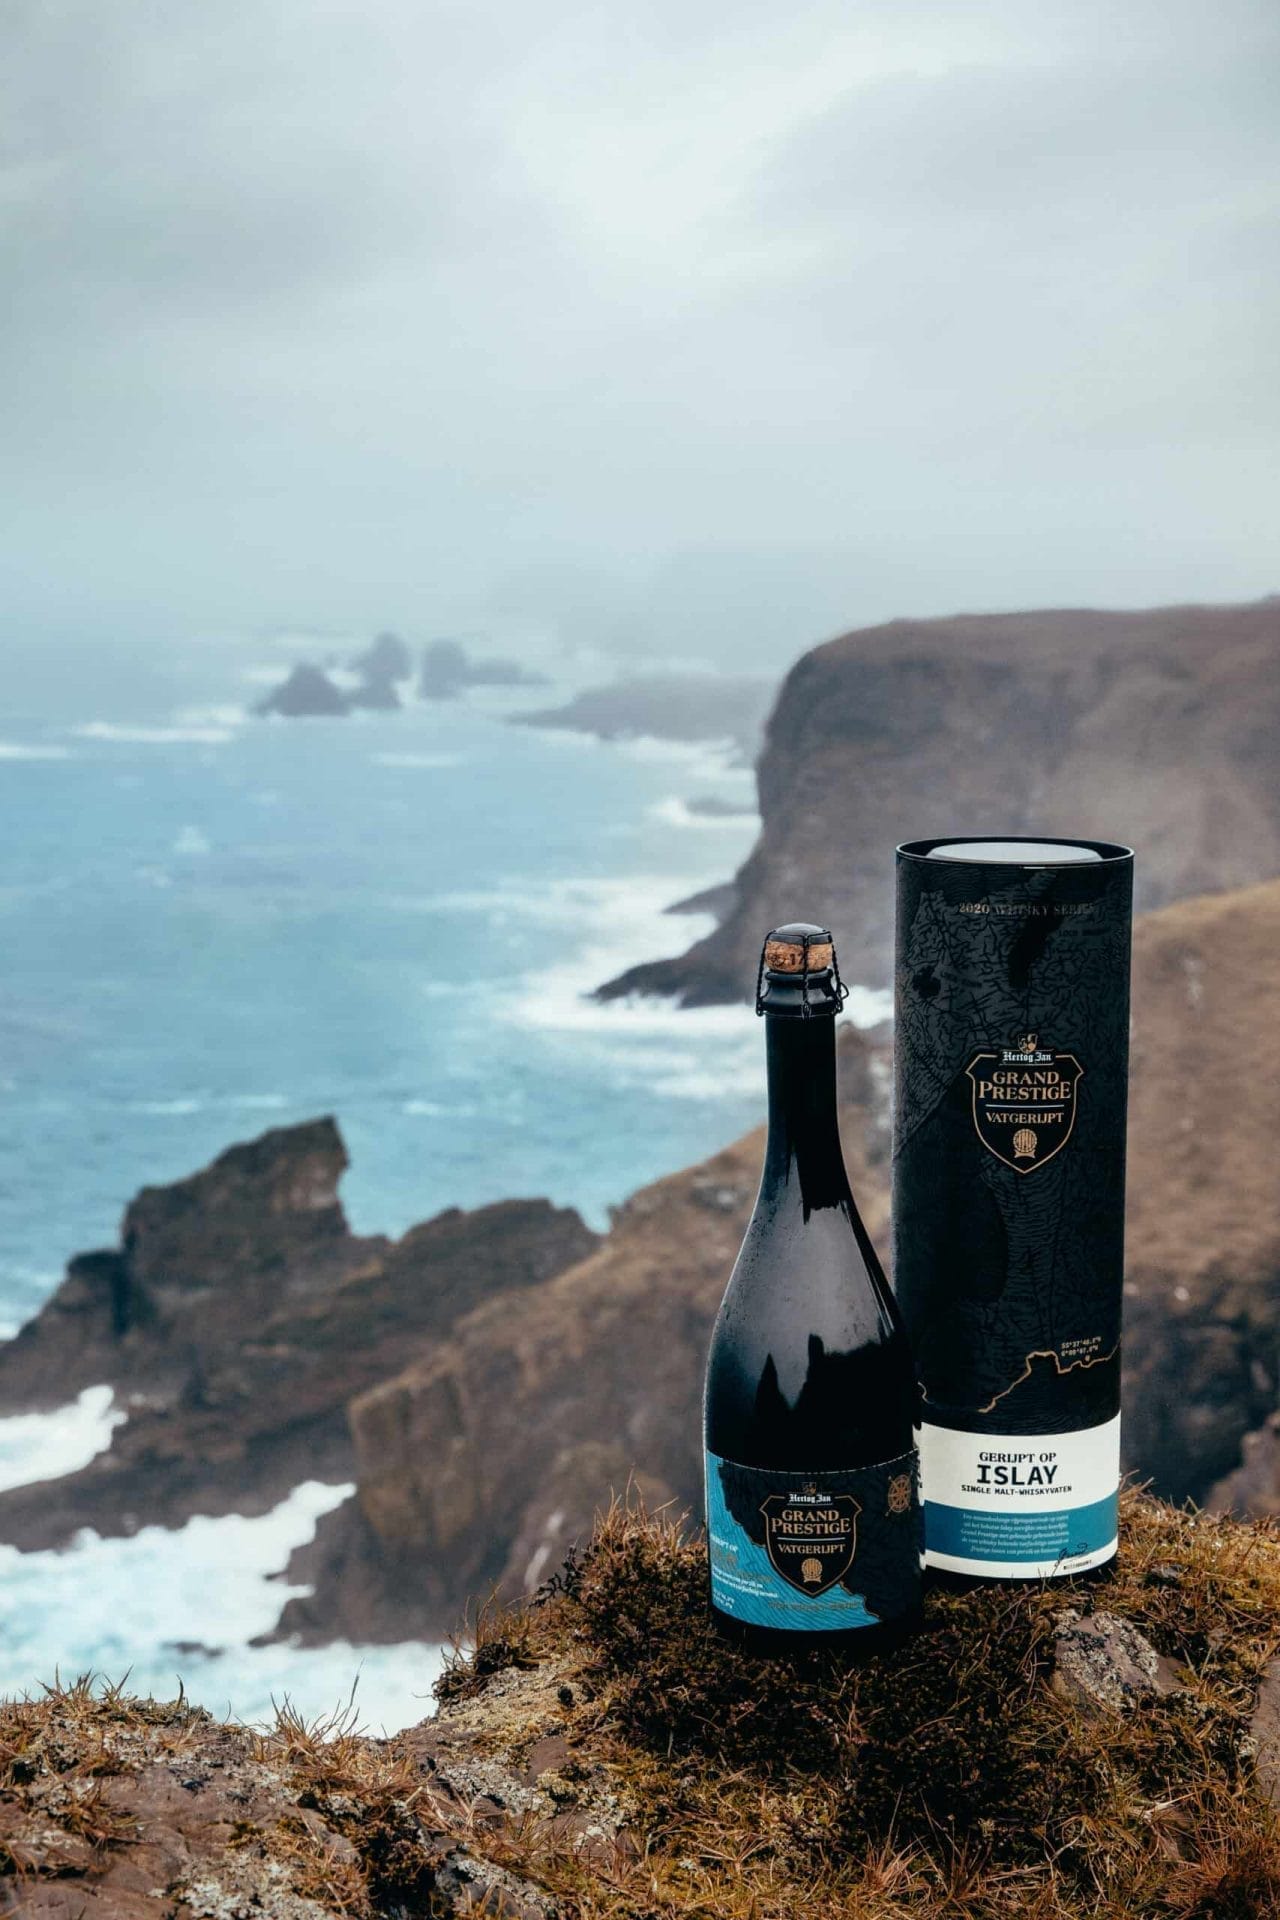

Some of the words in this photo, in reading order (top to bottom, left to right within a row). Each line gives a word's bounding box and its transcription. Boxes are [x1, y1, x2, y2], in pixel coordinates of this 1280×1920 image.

[959, 903, 990, 914] 2020
[1002, 1051, 1034, 1063] Hertog
[1035, 1051, 1052, 1062] Jan
[992, 1071, 1060, 1085] GRAND
[978, 1080, 1072, 1100] PRESTIGE
[985, 1112, 1065, 1124] VATGERIJPT
[979, 1451, 1036, 1464] GERIJPT
[1039, 1452, 1057, 1463] OP
[977, 1464, 1059, 1486] ISLAY
[961, 1484, 992, 1495] SINGLE
[994, 1485, 1073, 1496] MALT-WHISKYVATEN
[788, 1493, 816, 1504] Hertog
[816, 1494, 832, 1503] Jan
[781, 1509, 840, 1522] GRAND
[771, 1517, 852, 1535] PRESTIGE
[777, 1543, 847, 1554] VATGERIJPT
